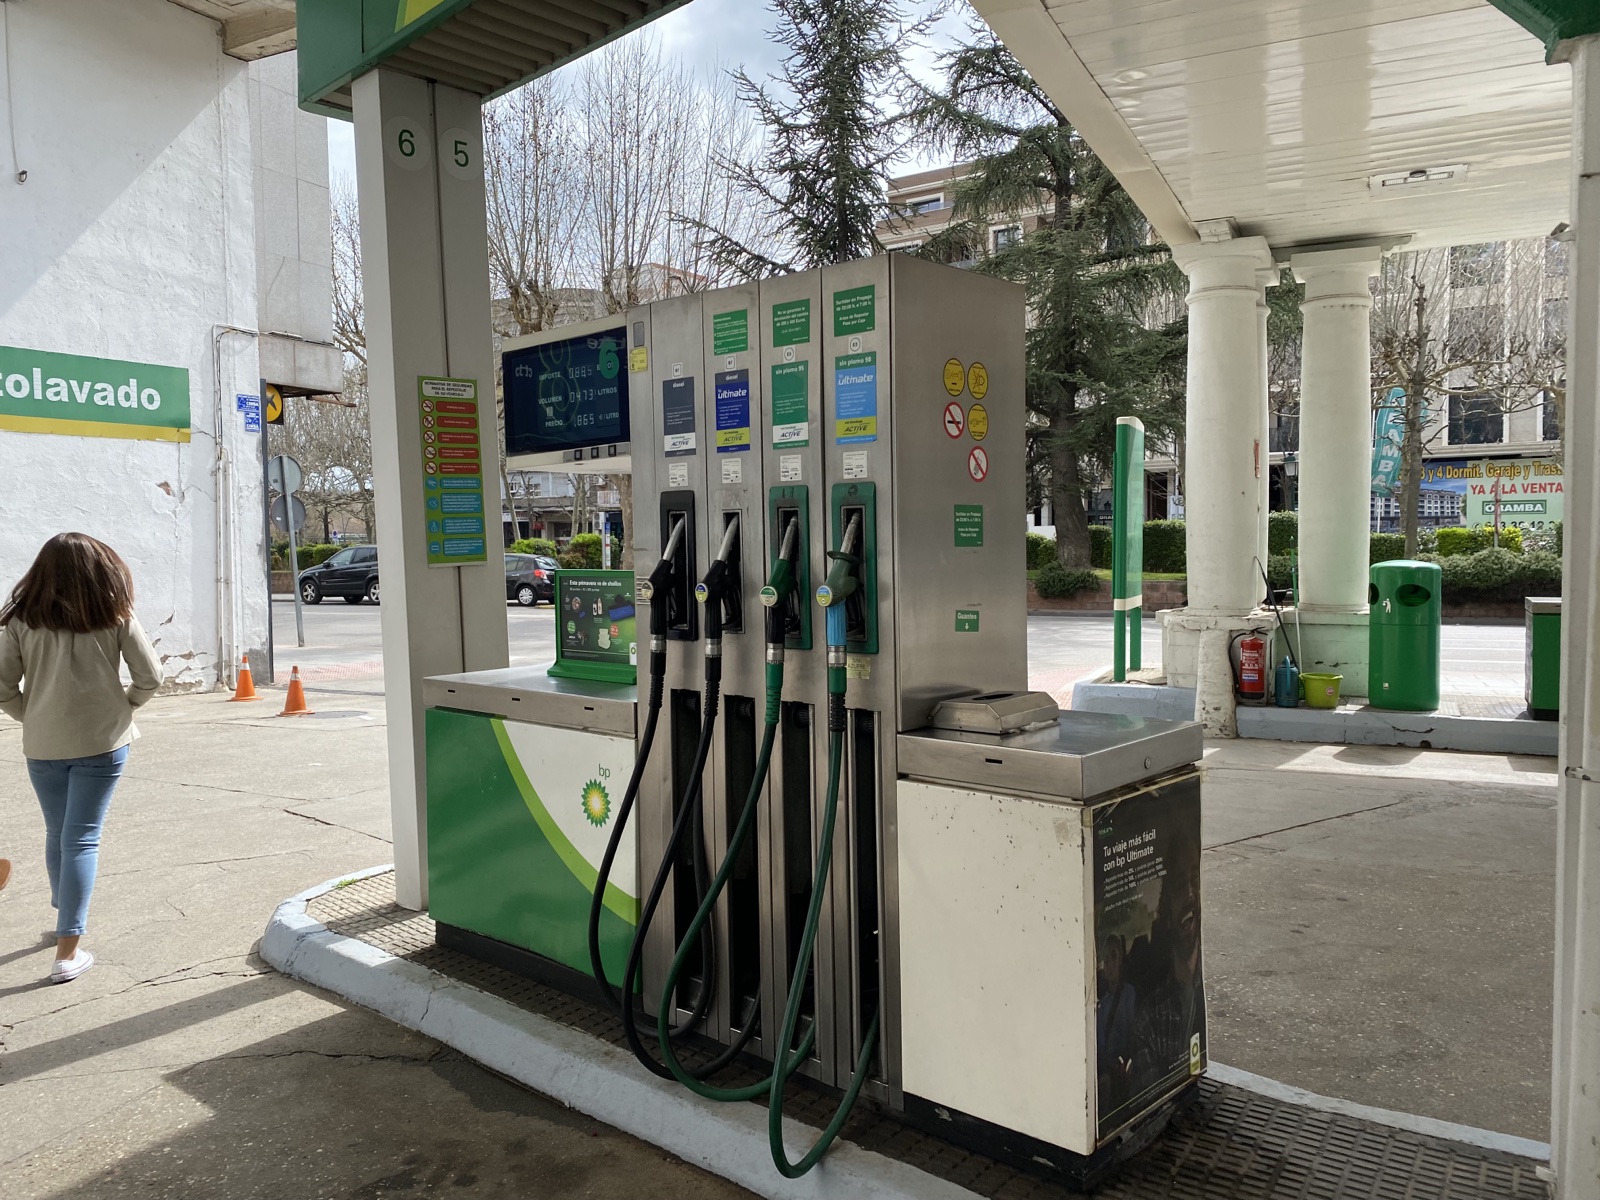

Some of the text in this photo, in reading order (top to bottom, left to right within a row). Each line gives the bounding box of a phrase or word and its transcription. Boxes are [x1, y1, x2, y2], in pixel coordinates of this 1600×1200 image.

[398, 129, 416, 157] 6
[454, 140, 469, 168] 5
[599, 339, 619, 379] 6
[848, 358, 864, 366] plomo
[838, 374, 873, 385] ultimate
[718, 388, 747, 399] ultimate
[1428, 470, 1434, 482] y
[1436, 467, 1443, 478] 4
[1446, 464, 1483, 479] Dormit.
[1486, 463, 1520, 480] Garaje
[1523, 465, 1531, 480] y
[1471, 484, 1486, 495] YA
[1502, 484, 1517, 494] LA
[1522, 483, 1563, 494] VENTA
[599, 764, 610, 780] bp
[1103, 829, 1156, 857] Tu viaje más fácil
[1103, 845, 1154, 872] con bp Ultimate
